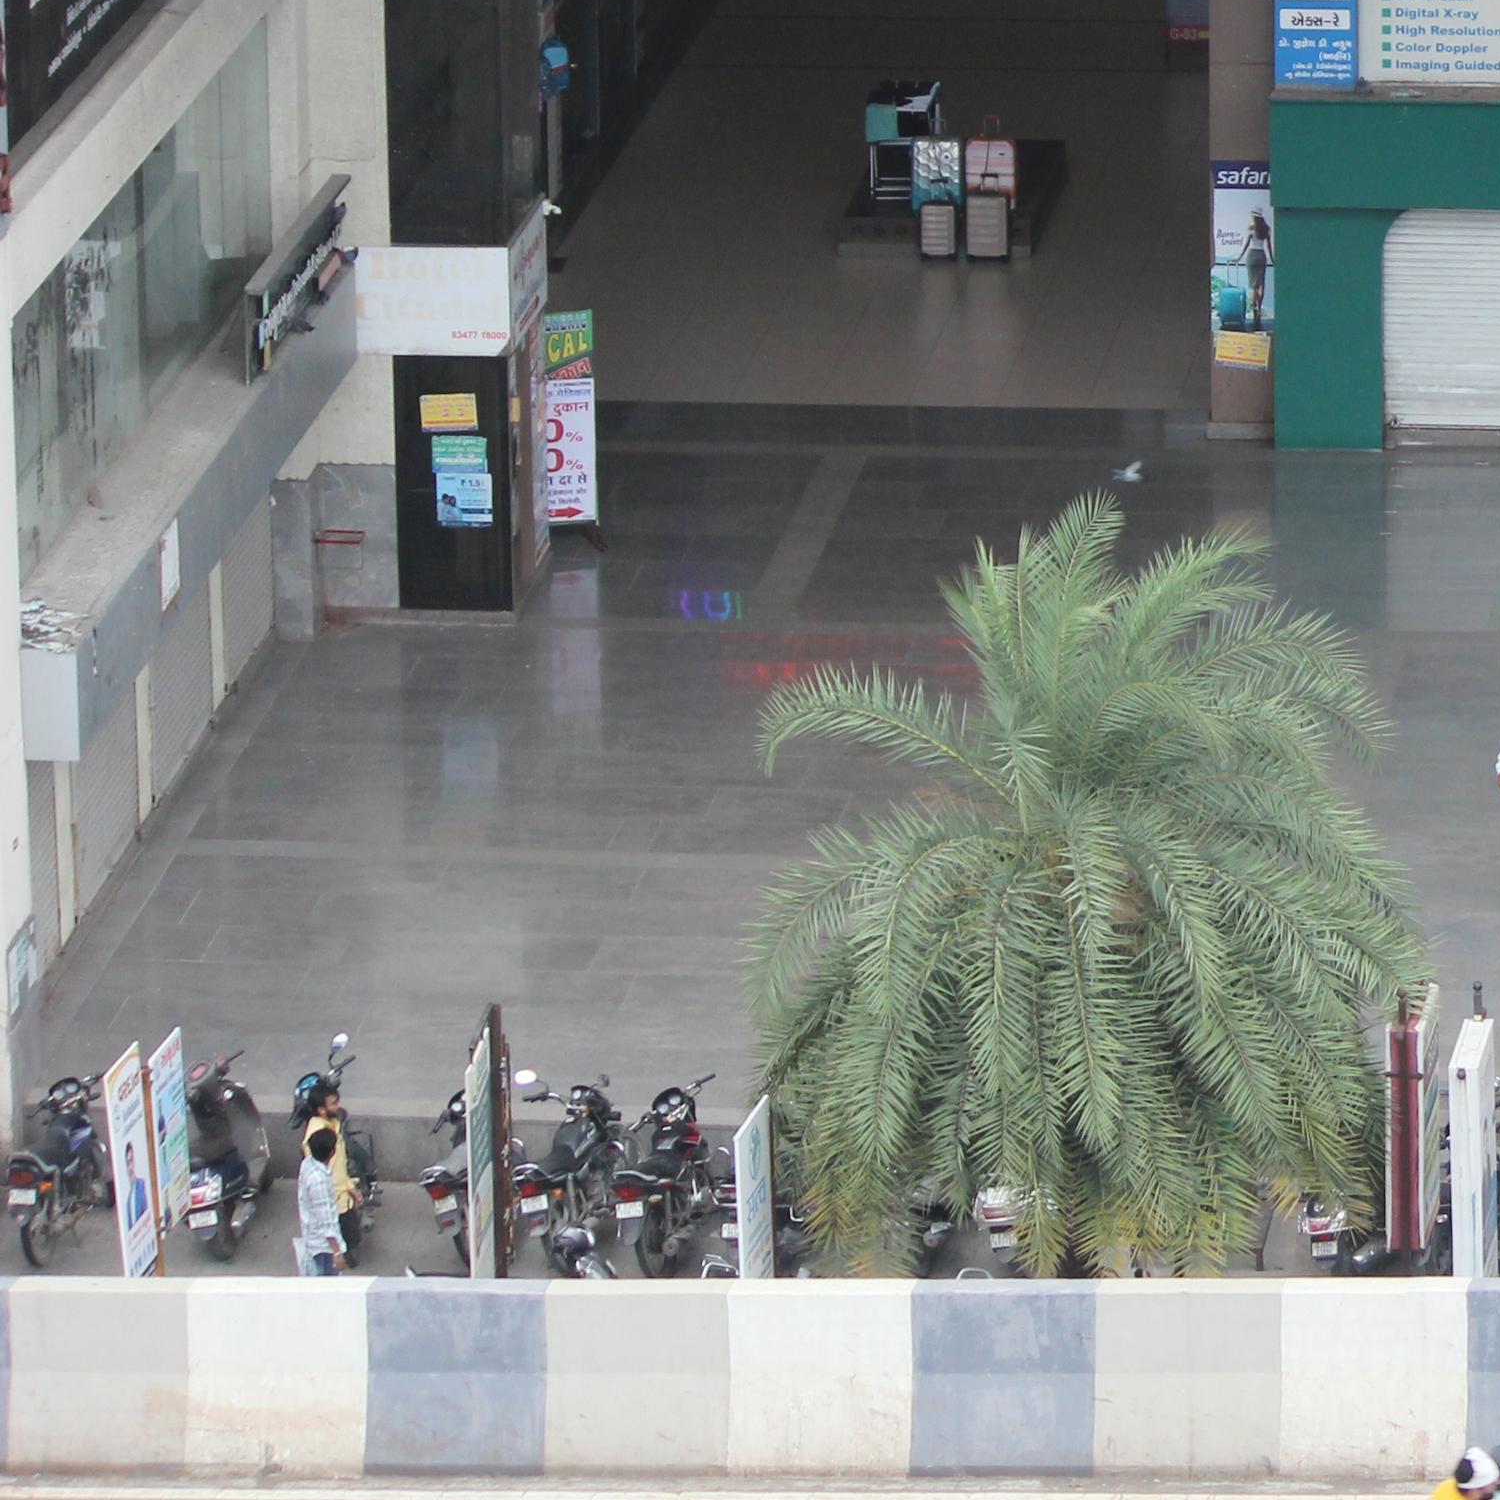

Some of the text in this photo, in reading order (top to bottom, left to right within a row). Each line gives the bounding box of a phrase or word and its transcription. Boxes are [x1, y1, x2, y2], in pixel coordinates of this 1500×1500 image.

[1394, 7, 1479, 21] Digital X-ray
[1394, 25, 1425, 38] High
[1395, 42, 1488, 56] Color Doppler
[1395, 59, 1450, 74] Imaging
[552, 400, 590, 417] दुकान
